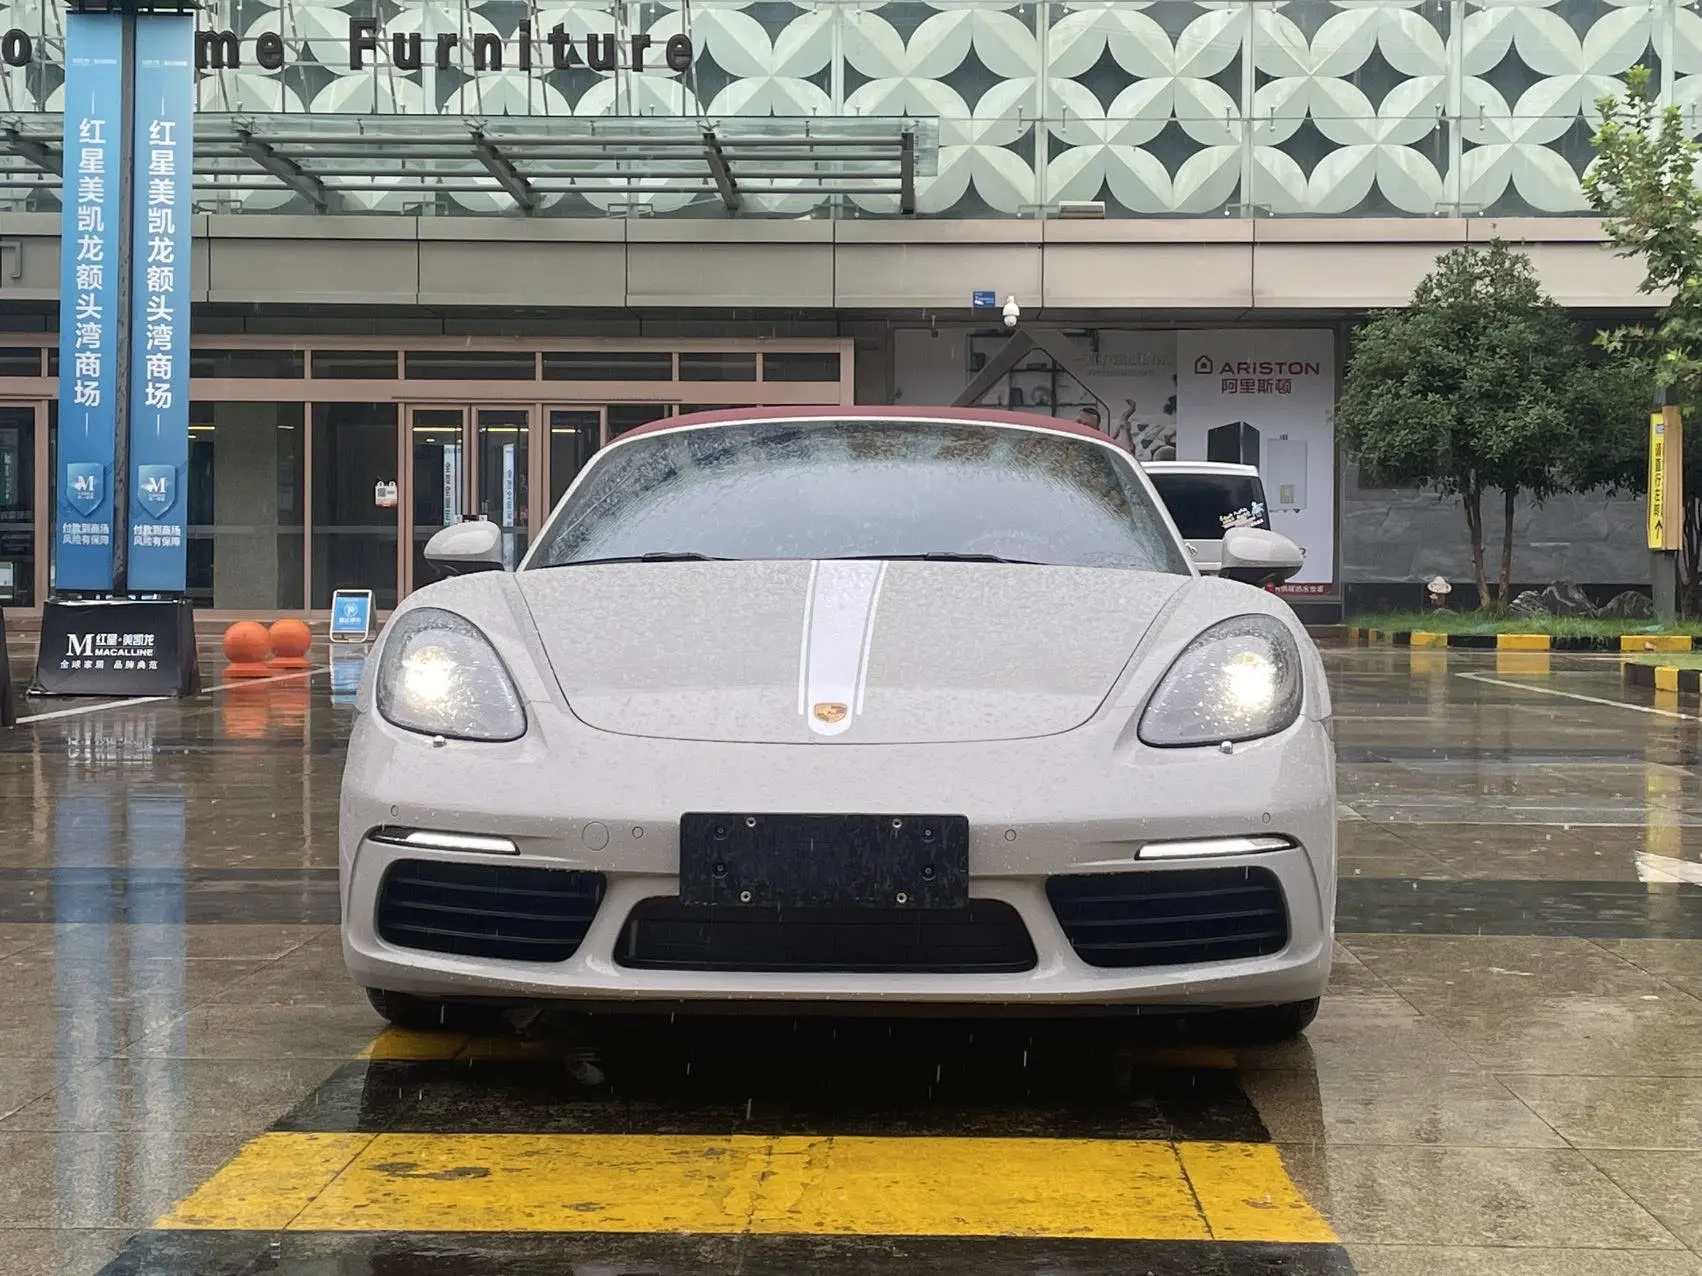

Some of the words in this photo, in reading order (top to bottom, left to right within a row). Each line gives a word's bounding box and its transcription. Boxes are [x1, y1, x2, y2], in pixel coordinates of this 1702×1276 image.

[349, 17, 694, 72] Furniture
[74, 118, 106, 407] 红星美凯龙额头湾商场
[145, 119, 176, 409] 红星美凯龙额头湾商场
[1219, 361, 1320, 376] ARISTON
[1221, 377, 1292, 395] 阿里斯顿
[62, 535, 109, 545] 风险有保障
[133, 536, 180, 547] 风险有保障
[66, 633, 95, 657] M
[95, 648, 154, 657] MACALLINE
